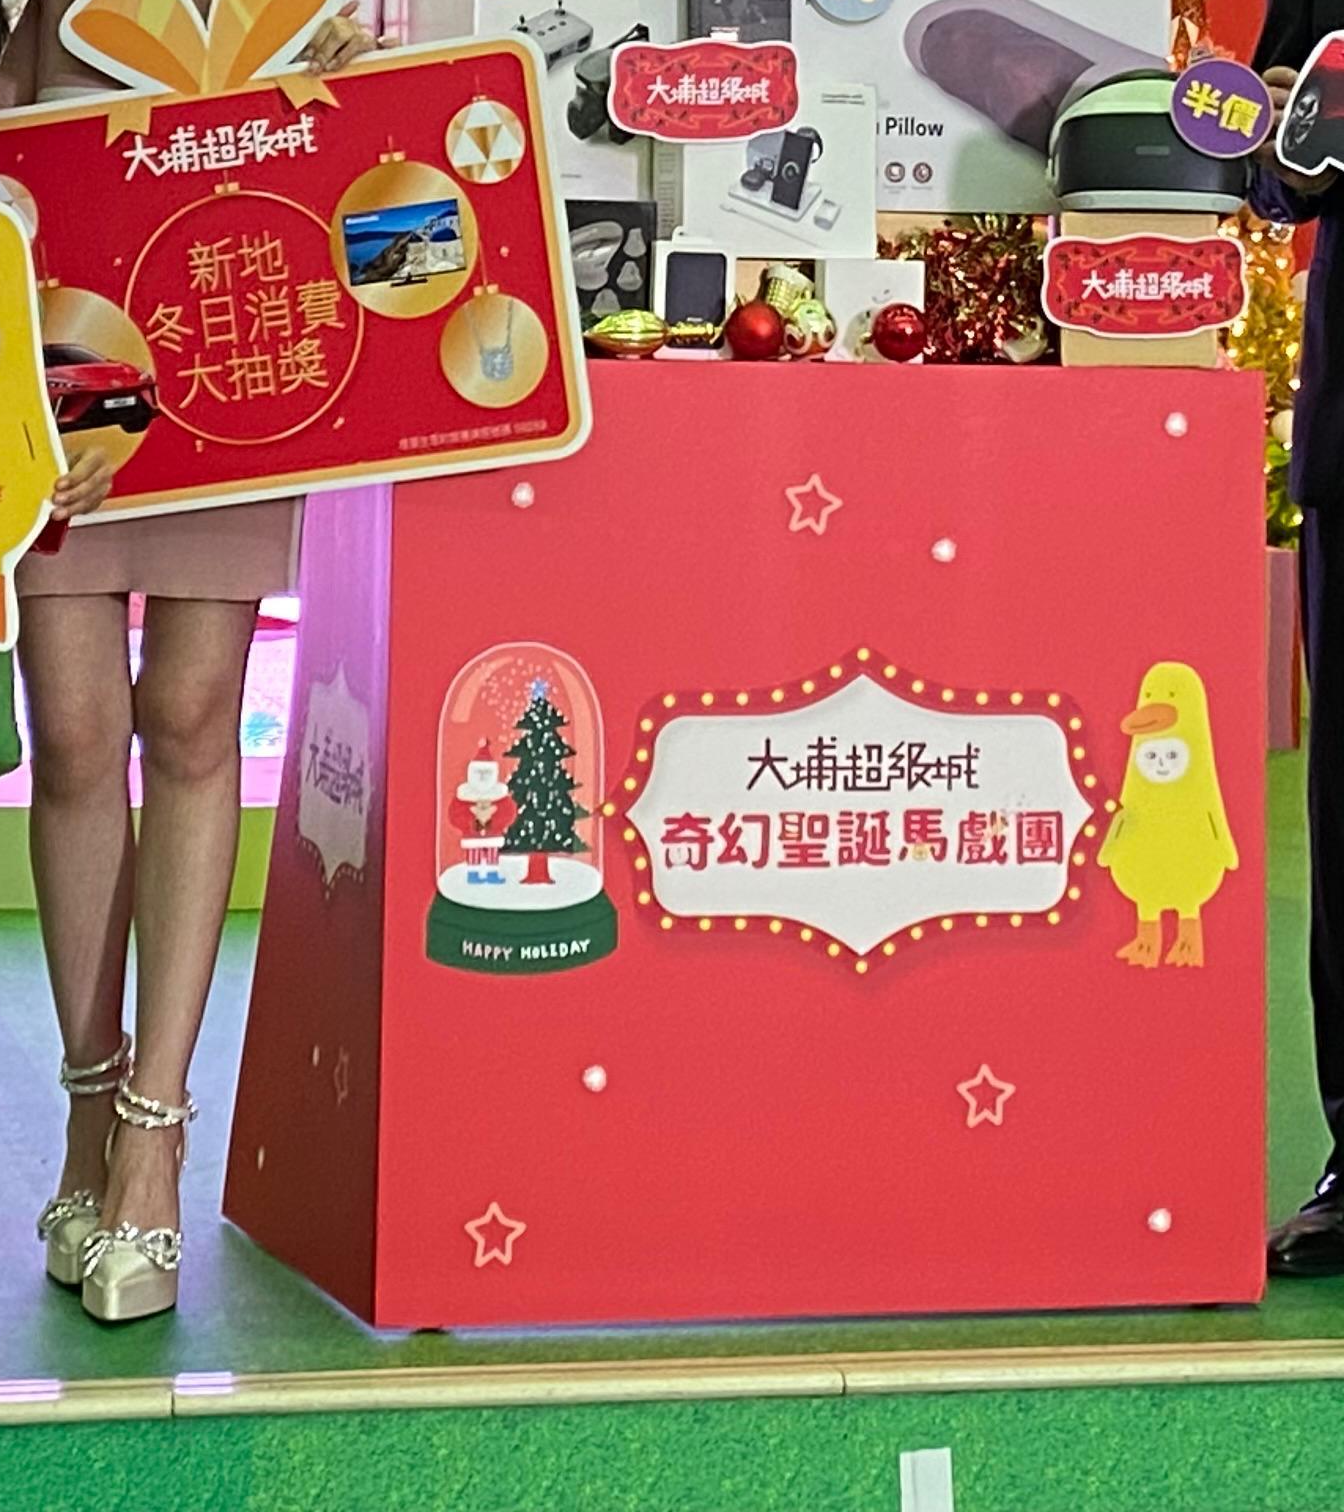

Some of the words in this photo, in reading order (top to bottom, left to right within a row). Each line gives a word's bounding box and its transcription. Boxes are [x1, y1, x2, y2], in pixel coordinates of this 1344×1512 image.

[646, 72, 771, 106] 大埔超級城
[1180, 78, 1265, 139] 半價
[122, 113, 319, 182] 大埔超級城
[885, 115, 945, 137] Pillow
[186, 229, 290, 293] 新地
[1081, 268, 1214, 301] 大埔超級城
[145, 278, 347, 355] 冬日消費
[177, 336, 330, 410] 大抽獎
[745, 735, 982, 792] 大埔超級城
[660, 807, 1066, 870] 奇幻聖誕馬戲團
[461, 939, 514, 962] HAPPY
[519, 938, 592, 960] HOLIDAY
